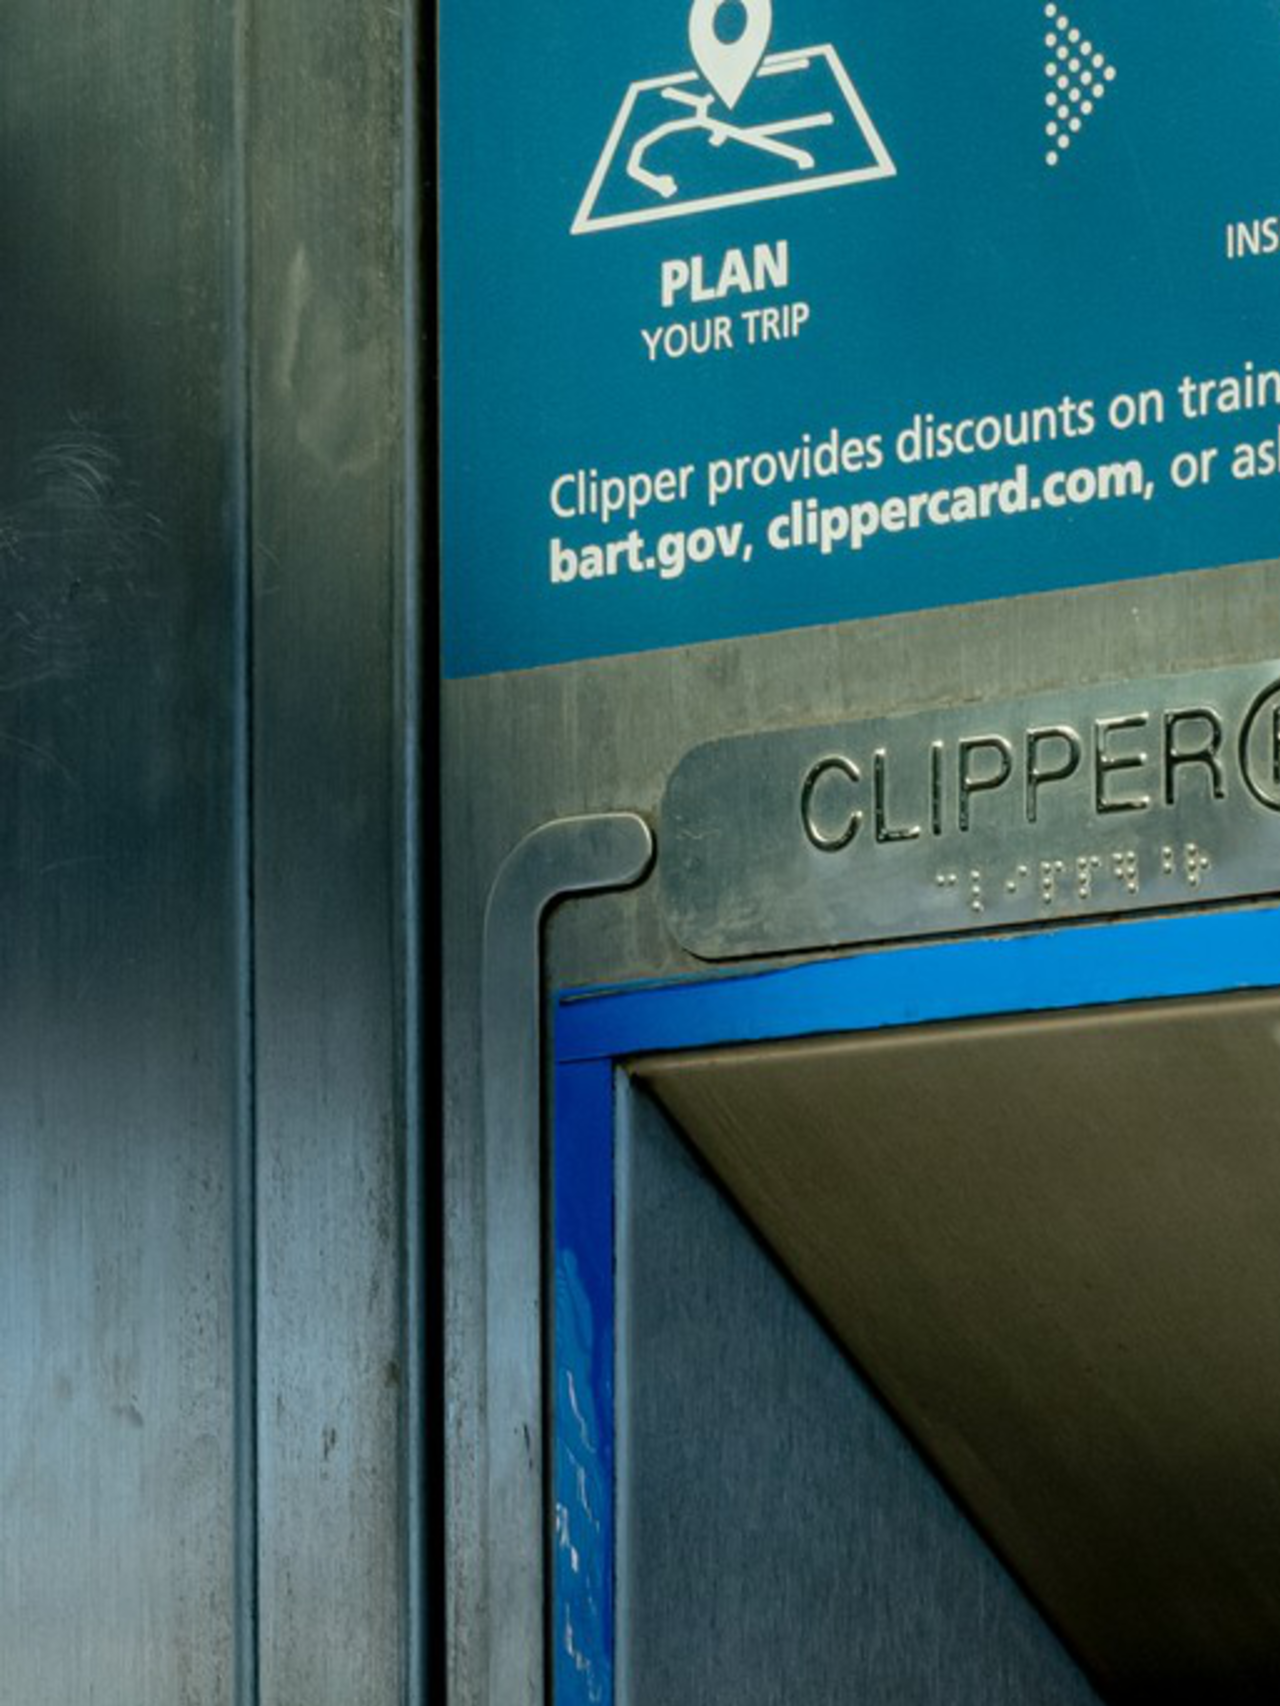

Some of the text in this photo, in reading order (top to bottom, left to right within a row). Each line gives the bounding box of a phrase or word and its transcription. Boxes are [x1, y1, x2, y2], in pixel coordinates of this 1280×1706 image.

[661, 240, 790, 308] PLAN
[641, 302, 811, 362] YOUR TRIP
[549, 460, 695, 524] Clipper
[707, 425, 883, 500] provides
[896, 396, 1095, 464] discounts
[1109, 383, 1164, 430] on
[549, 520, 754, 583] bart.gov,
[768, 457, 1155, 553] clippercard.com,
[1170, 449, 1215, 488] or
